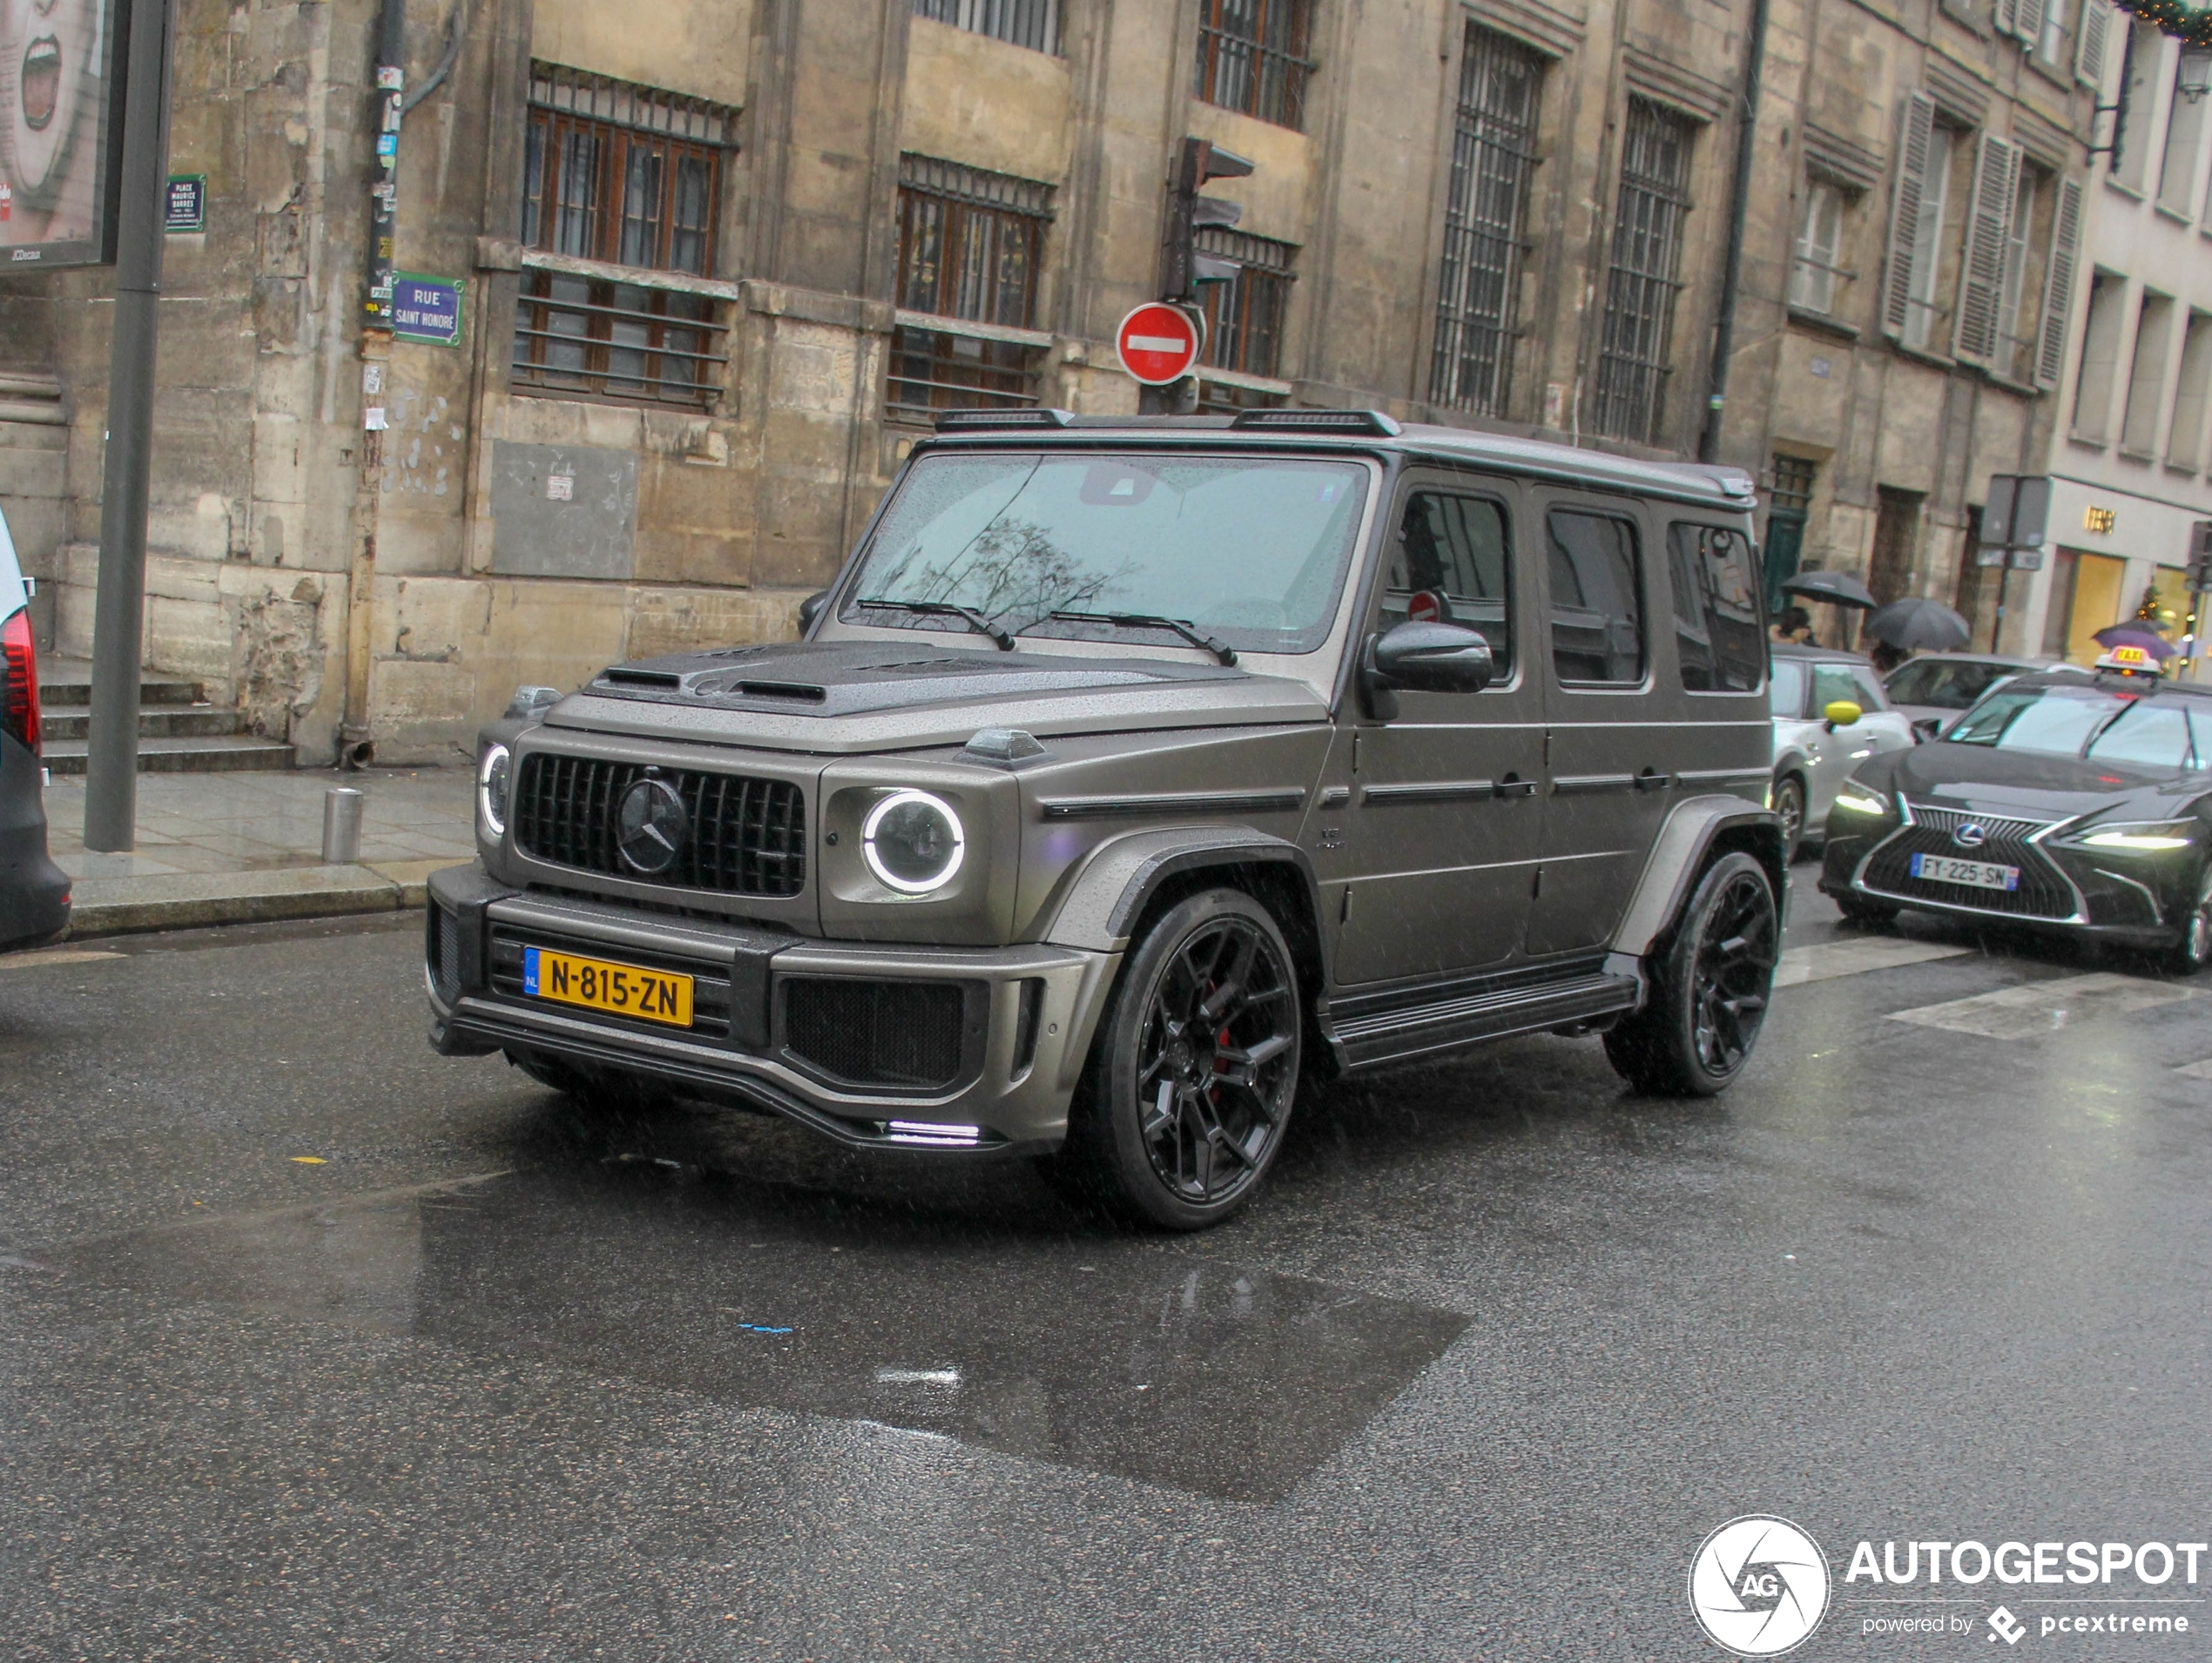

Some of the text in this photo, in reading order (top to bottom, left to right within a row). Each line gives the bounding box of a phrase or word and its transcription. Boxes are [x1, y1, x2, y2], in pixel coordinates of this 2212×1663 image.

[171, 192, 196, 200] MAURICE
[11, 249, 41, 260] JCDecaux
[414, 289, 440, 306] RUE
[396, 309, 420, 325] SAINT
[2118, 648, 2142, 662] TAXI
[1922, 858, 2006, 885] FY-225-SN
[526, 976, 538, 988] NL
[551, 959, 678, 1017] N-815-ZN
